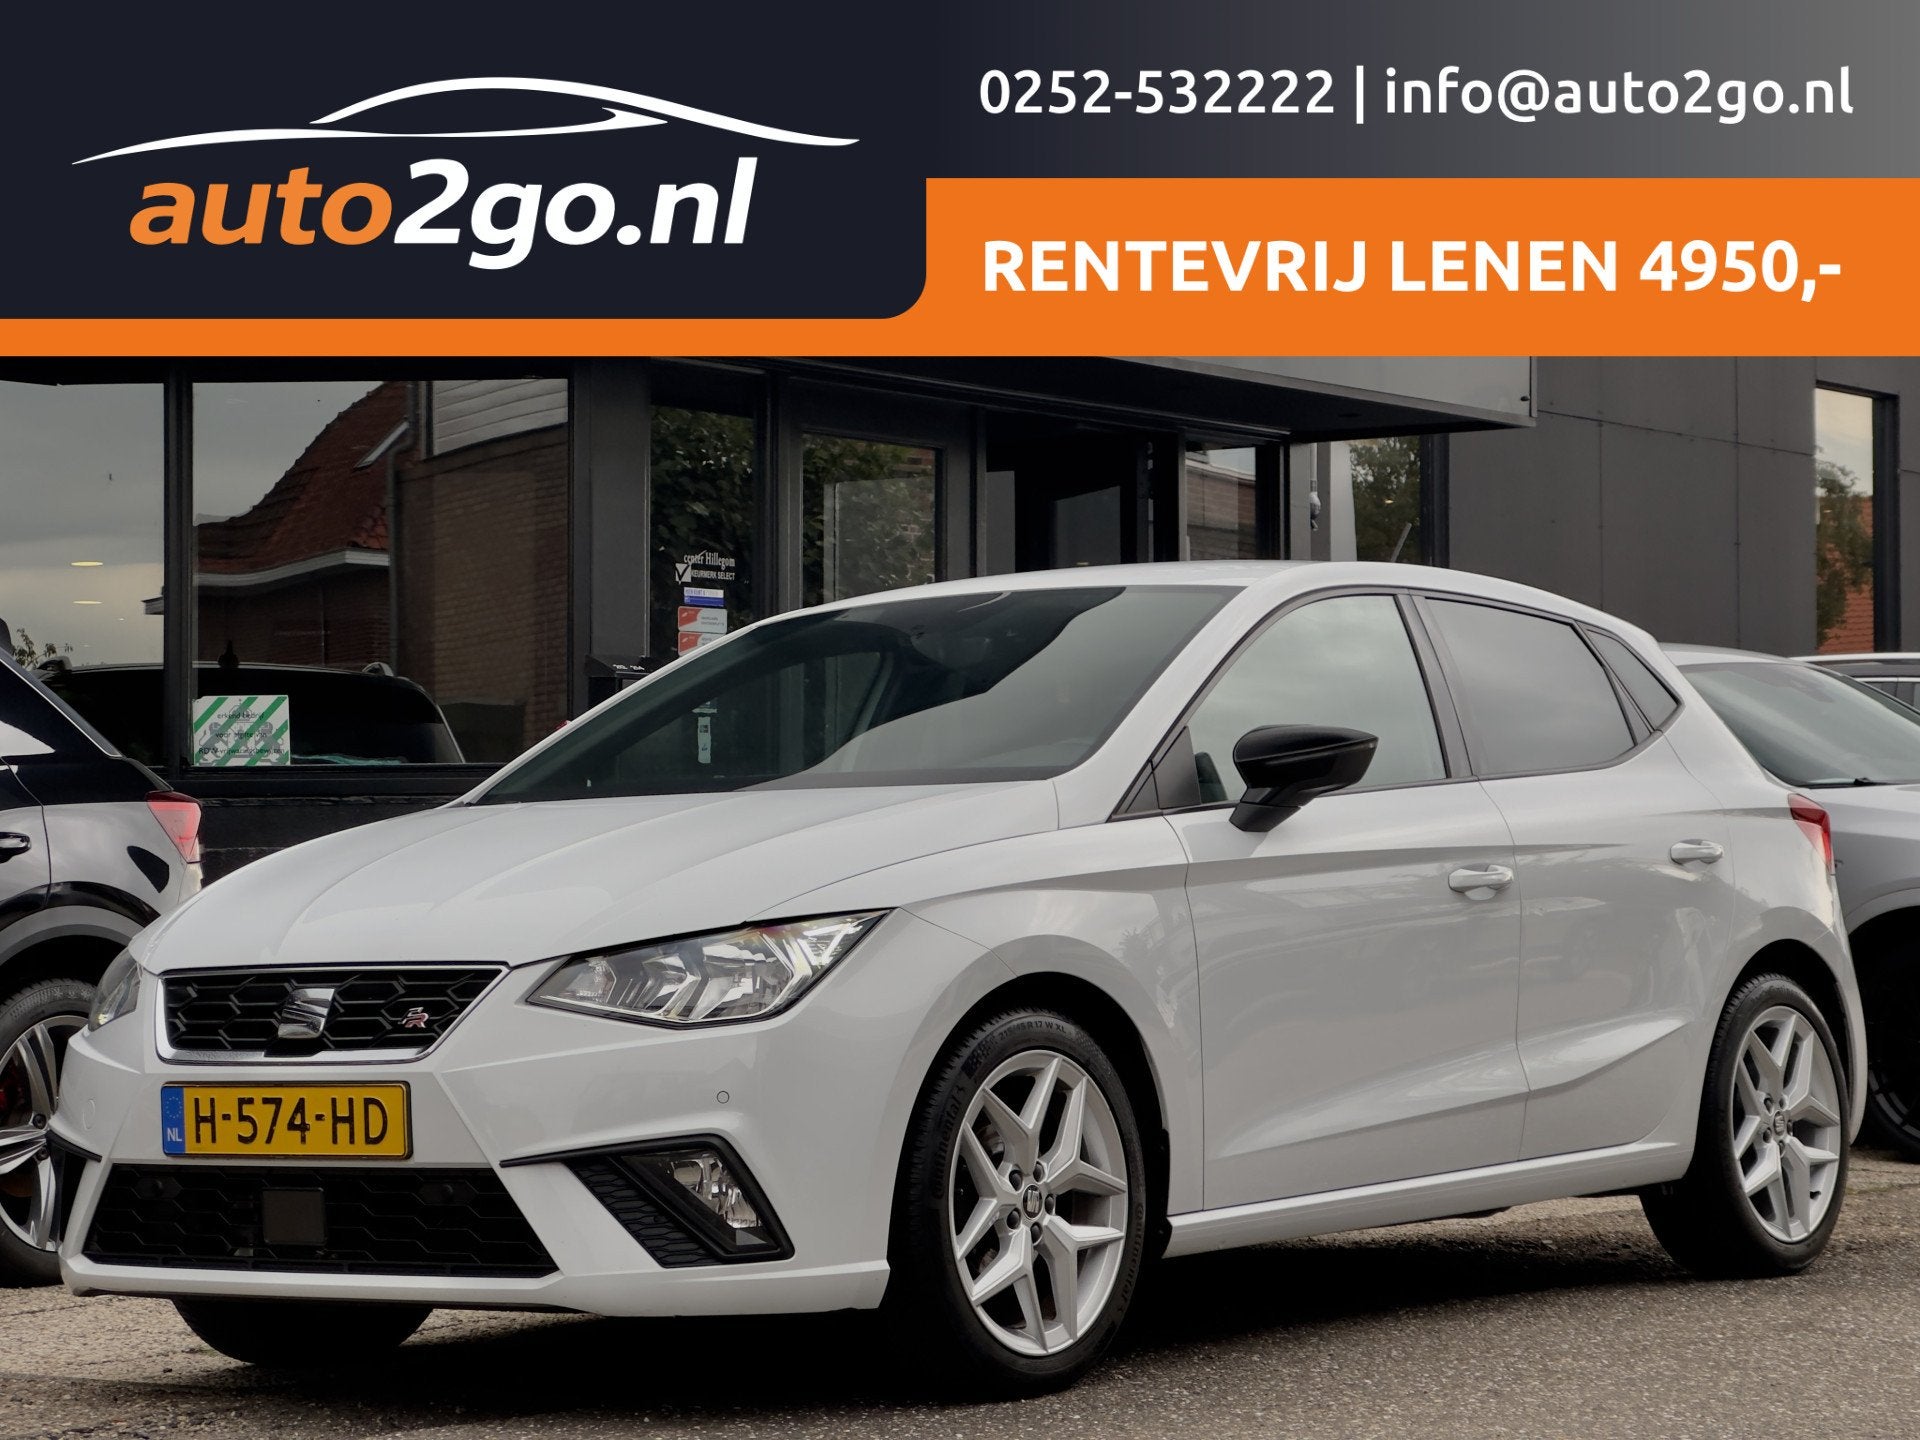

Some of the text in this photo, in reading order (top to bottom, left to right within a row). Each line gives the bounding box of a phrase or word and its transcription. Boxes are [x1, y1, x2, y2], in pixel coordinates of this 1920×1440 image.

[706, 552, 736, 570] Hillegom
[717, 571, 736, 581] SELECT
[194, 1097, 388, 1145] H-574-HD
[167, 1127, 182, 1142] NL
